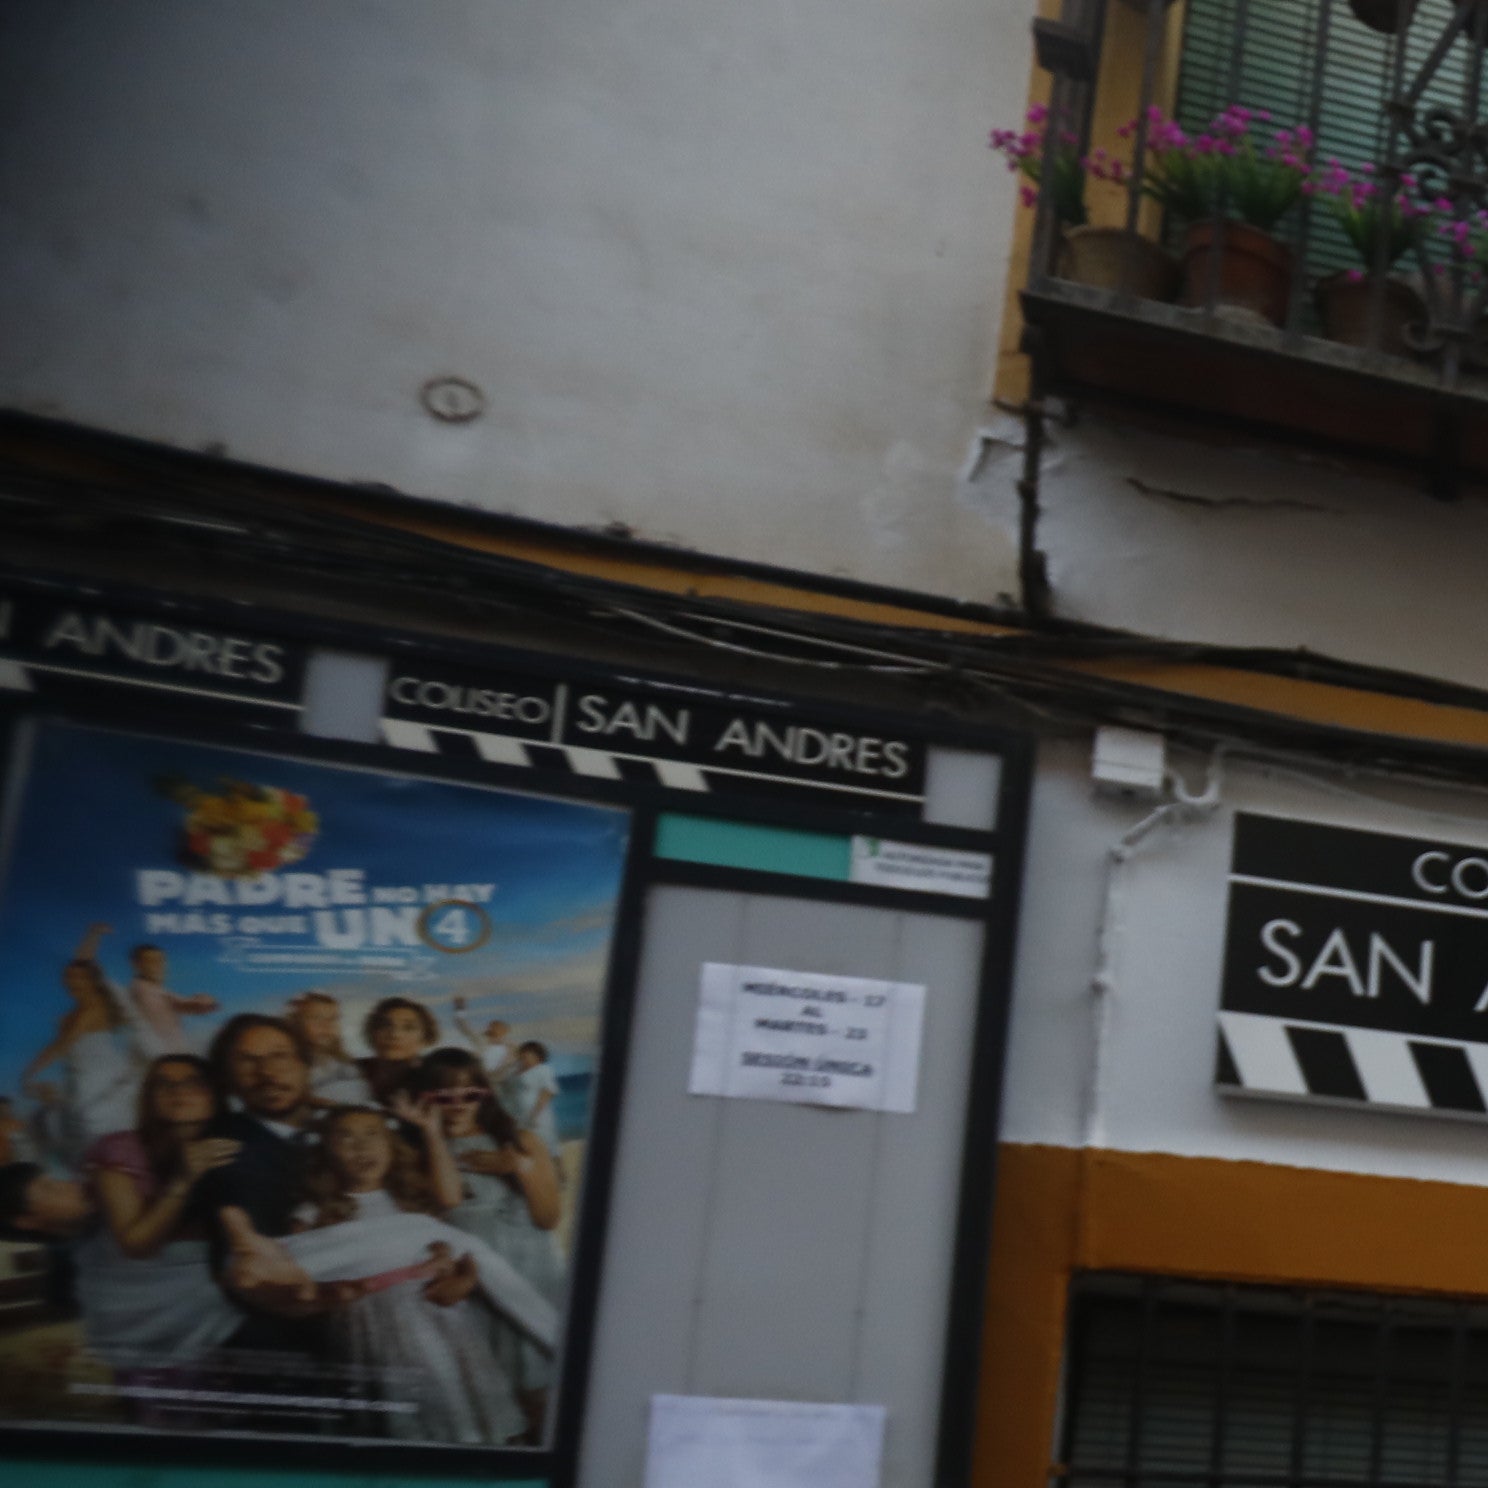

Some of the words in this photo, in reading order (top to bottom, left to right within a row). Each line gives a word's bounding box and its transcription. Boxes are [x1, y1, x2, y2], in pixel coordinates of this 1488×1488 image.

[46, 611, 284, 684] ANDRES
[390, 676, 550, 724] COLISEO
[575, 695, 690, 745] SAN
[714, 718, 908, 778] ANDRES
[136, 868, 367, 908] PADRE
[312, 906, 421, 949] UN
[433, 909, 470, 945] 4
[1257, 918, 1435, 1005] SAN
